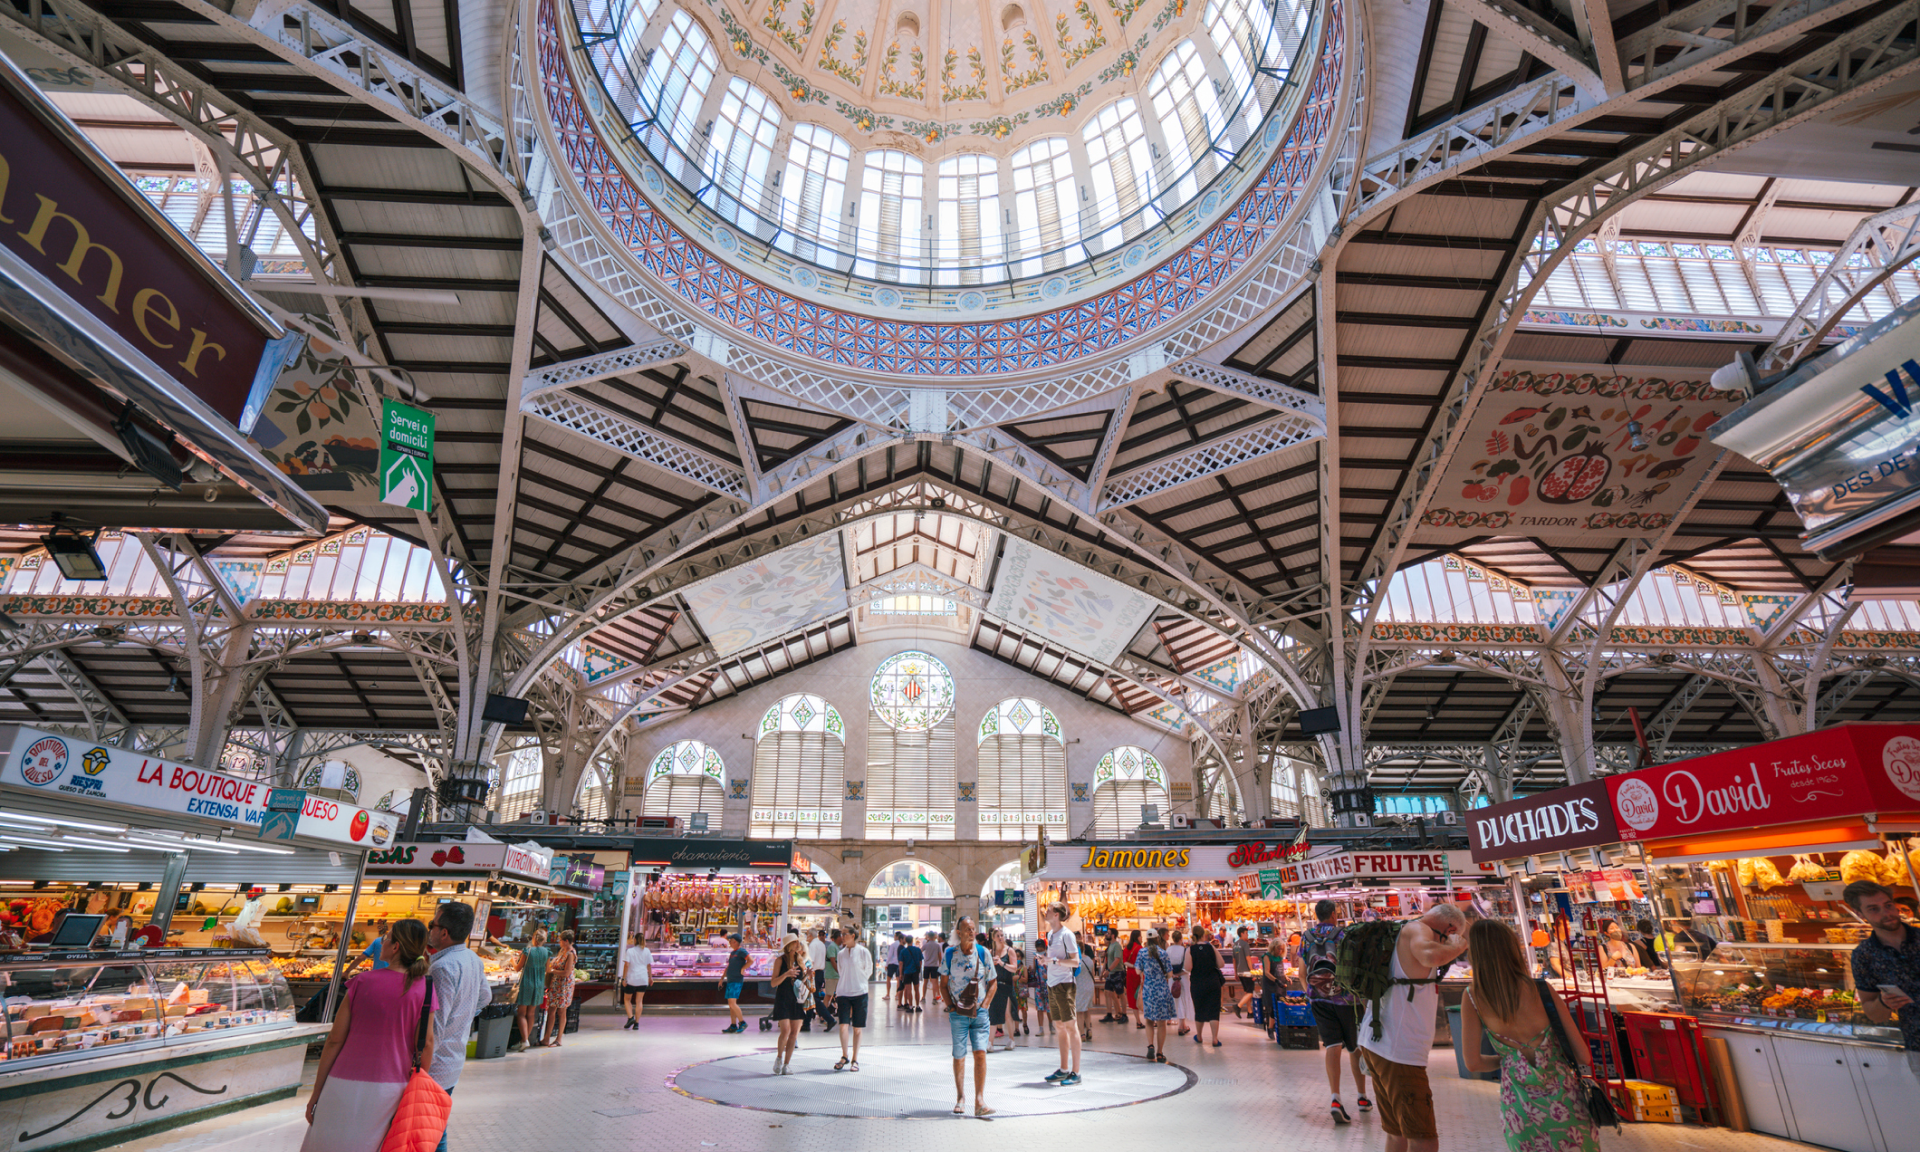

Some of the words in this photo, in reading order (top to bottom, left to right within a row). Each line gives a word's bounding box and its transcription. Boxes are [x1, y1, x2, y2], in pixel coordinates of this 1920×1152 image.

[391, 410, 421, 431] Servei
[422, 425, 428, 434] a
[390, 426, 427, 449] domicili
[1832, 471, 1874, 499] DES
[1519, 516, 1578, 527] TARDOR
[29, 739, 66, 760] BOUTIQUE
[38, 757, 50, 767] DEL
[1770, 759, 1812, 778] Frutos
[1811, 754, 1847, 771] Secos
[24, 766, 54, 783] QUESO
[137, 759, 163, 787] LA
[169, 767, 257, 805] BOUTIQUE
[1790, 778, 1815, 788] desde
[1816, 774, 1838, 784] 1963
[58, 784, 77, 794] QUESO
[1663, 763, 1771, 824] David
[187, 797, 239, 820] EXTENSA
[1621, 796, 1655, 819] David
[1476, 797, 1599, 849] PUCHADES
[1081, 845, 1191, 869] Jamones
[1301, 855, 1352, 880] FRUTAS
[1353, 854, 1444, 873] FRUTAS
